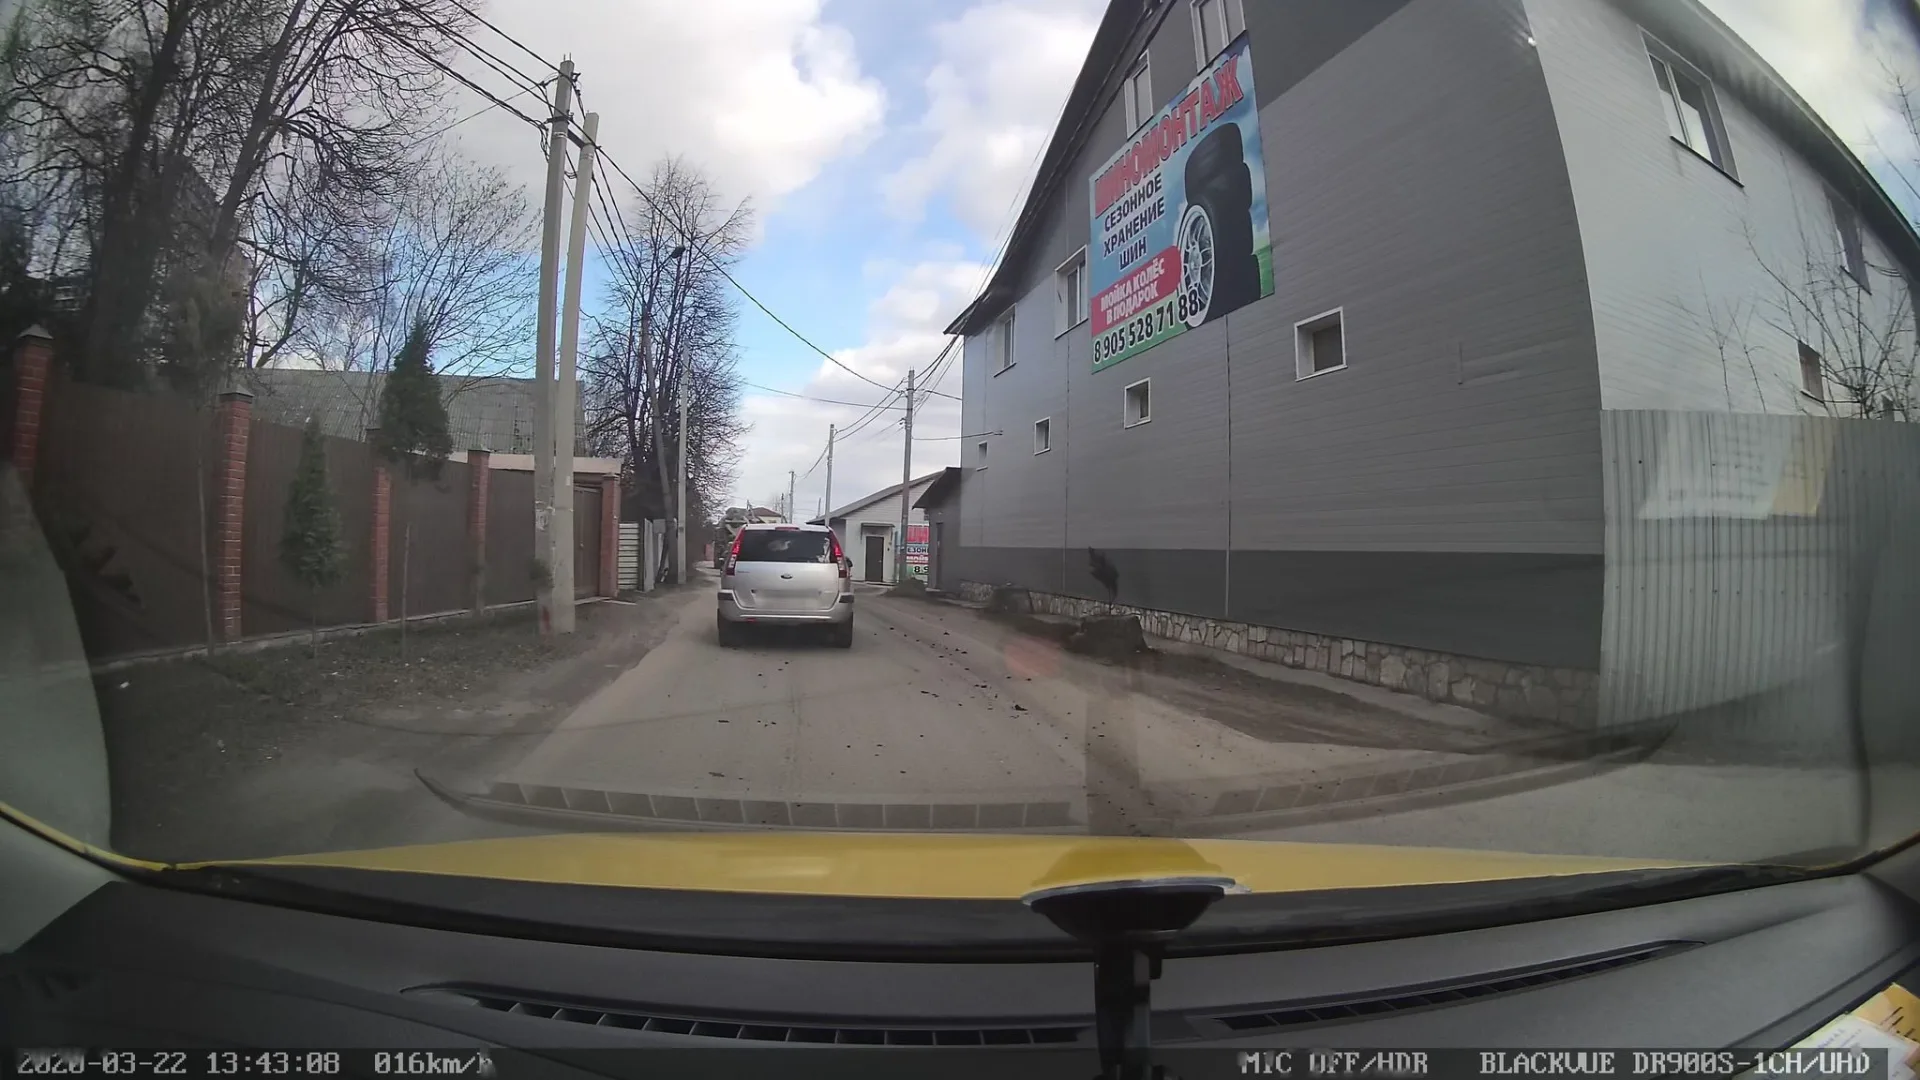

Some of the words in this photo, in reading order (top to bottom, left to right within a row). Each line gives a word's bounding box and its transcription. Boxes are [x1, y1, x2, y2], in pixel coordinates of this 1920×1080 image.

[1103, 196, 1165, 258] ХРАНЕНИЕ
[1104, 171, 1163, 232] СЕЗОННОЕ
[1119, 236, 1147, 271] ШИН
[1094, 340, 1101, 363] 8
[1103, 327, 1126, 359] 905
[1128, 312, 1153, 347] 528
[1156, 300, 1174, 333] 71
[1178, 288, 1199, 322] 88
[1113, 281, 1159, 321] ПОДАРОК
